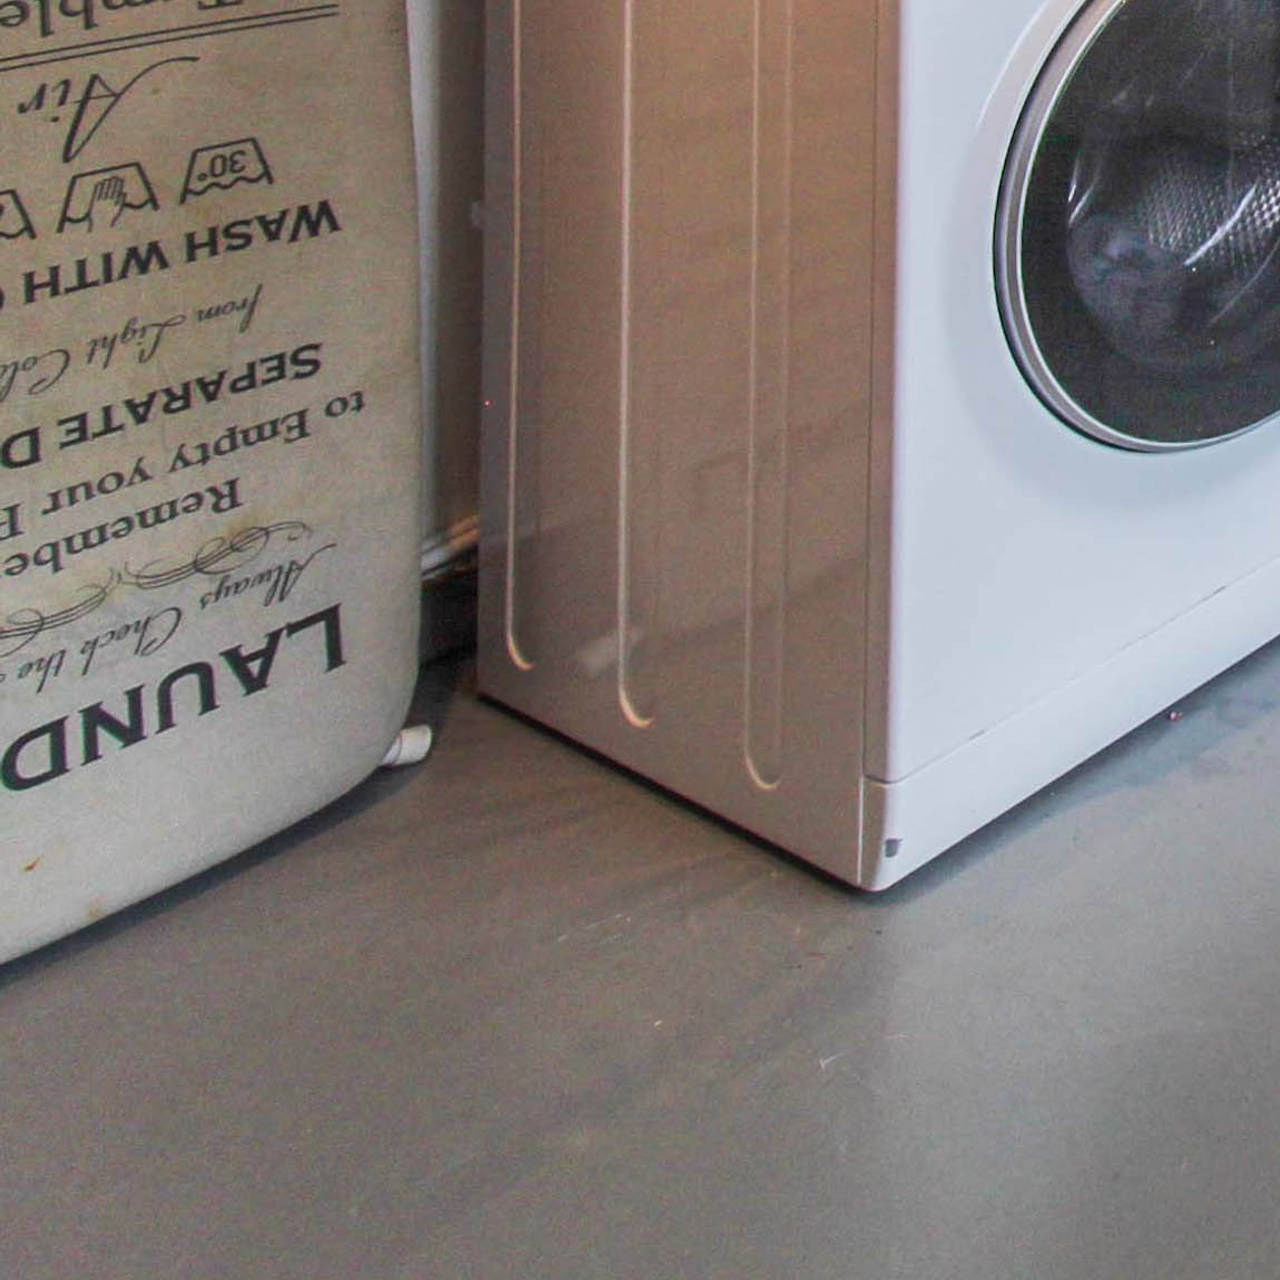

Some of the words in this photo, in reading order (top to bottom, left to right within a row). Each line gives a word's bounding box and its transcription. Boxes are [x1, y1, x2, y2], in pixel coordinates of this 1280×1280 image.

[18, 57, 200, 164] Air
[186, 200, 341, 263] WASH
[24, 241, 170, 305] WITH
[197, 284, 263, 334] from
[86, 315, 186, 369] Light
[57, 343, 322, 449] SEPARATE
[325, 391, 365, 418] to
[168, 408, 311, 473] Empty
[41, 457, 152, 516] your
[0, 478, 243, 578] Remembe
[199, 543, 336, 610] Always
[18, 649, 66, 693] the
[80, 607, 182, 676] Check
[0, 603, 346, 792] LAUND
